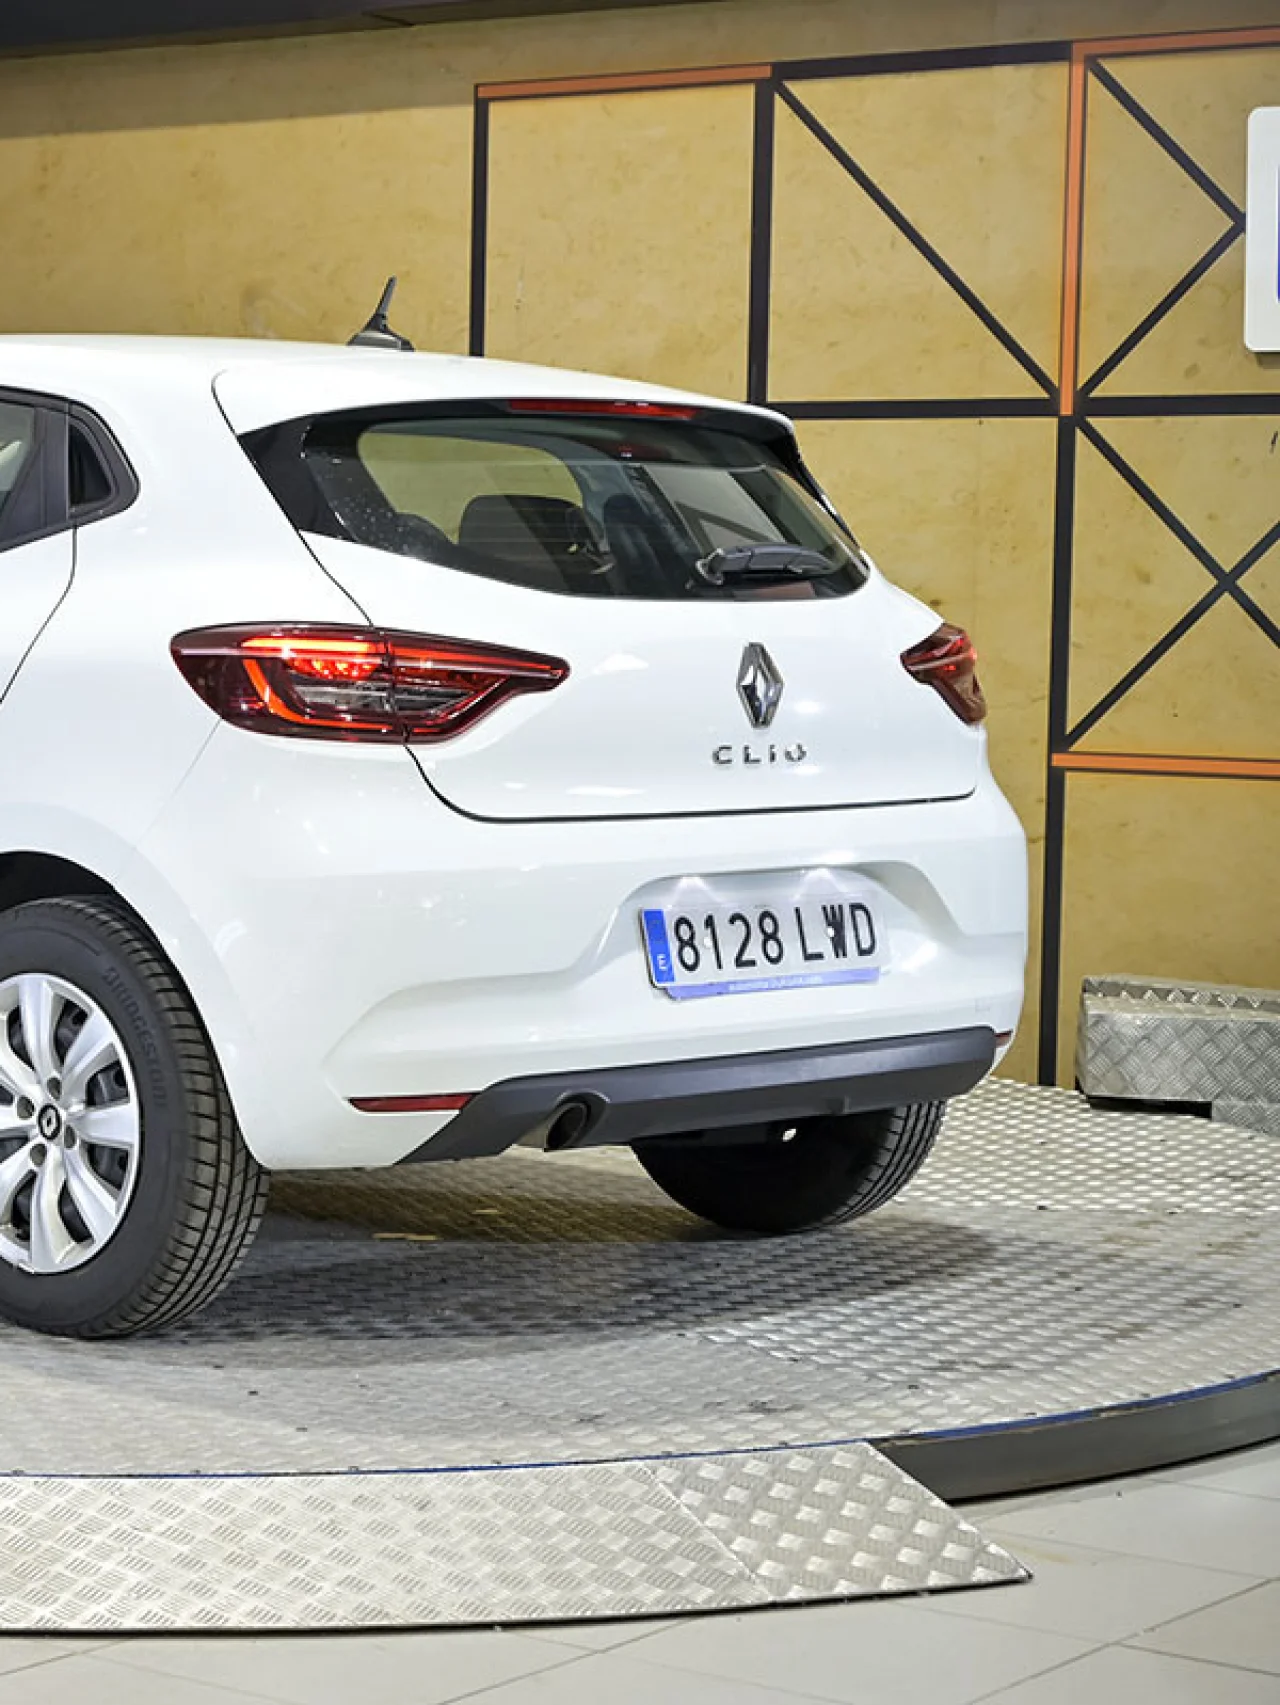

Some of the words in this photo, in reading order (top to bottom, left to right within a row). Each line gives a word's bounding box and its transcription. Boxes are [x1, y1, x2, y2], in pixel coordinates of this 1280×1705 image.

[712, 743, 807, 765] CLIO
[673, 910, 784, 973] 8128
[794, 902, 877, 962] LWD
